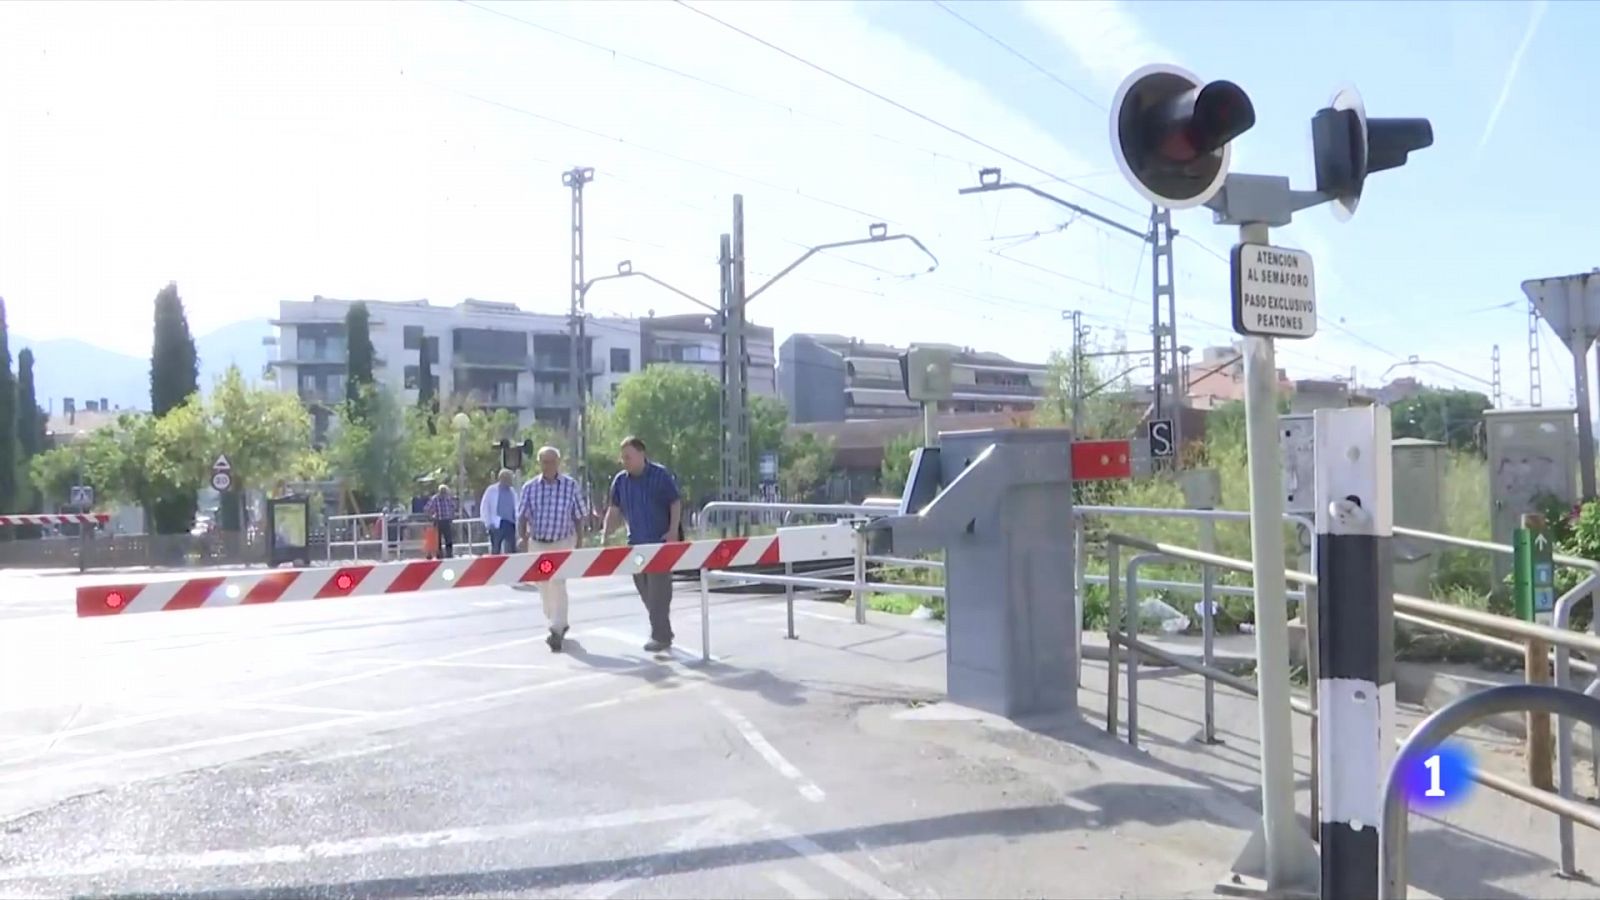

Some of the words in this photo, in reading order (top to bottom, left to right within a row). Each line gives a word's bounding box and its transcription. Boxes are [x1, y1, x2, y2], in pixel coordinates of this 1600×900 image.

[1248, 268, 1259, 282] AL
[1244, 293, 1266, 308] PASO
[1268, 296, 1313, 313] EXCLUSIVO
[1257, 313, 1303, 330] PEATONES
